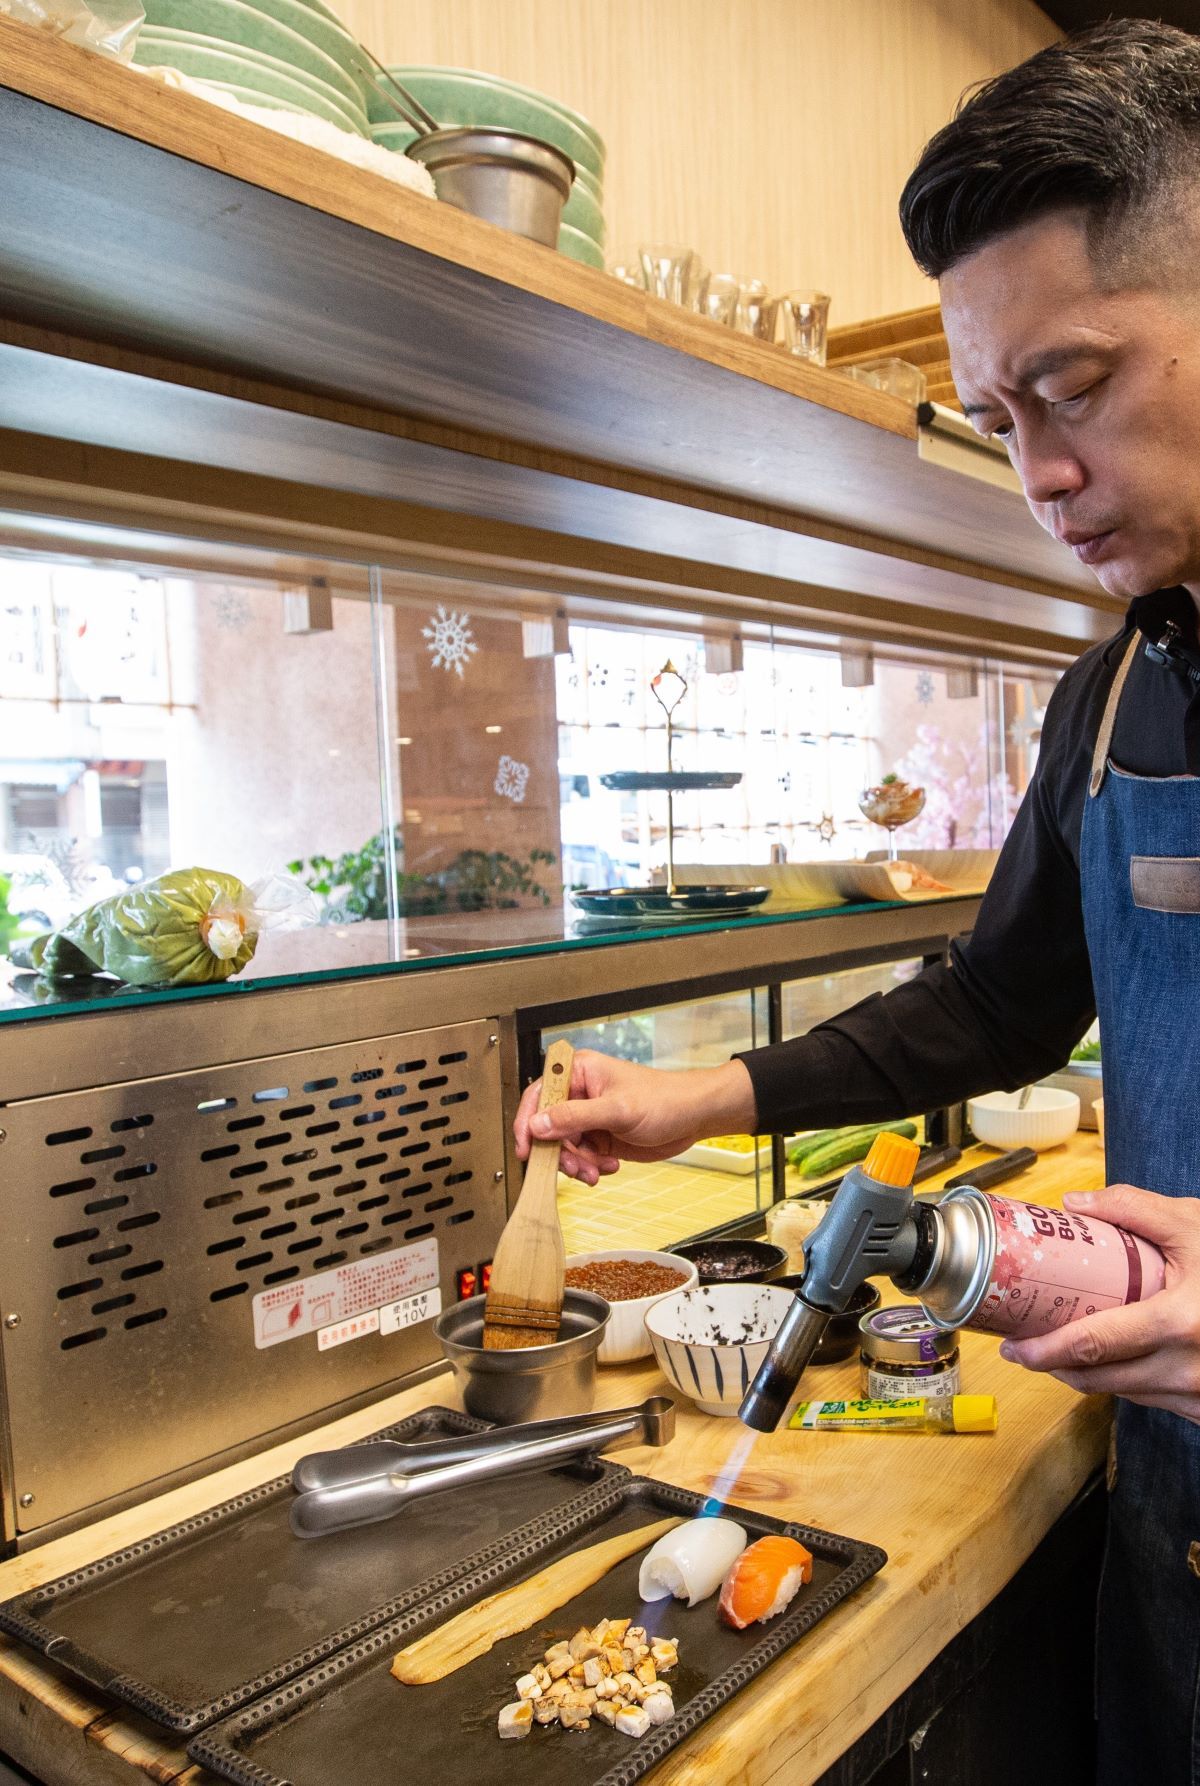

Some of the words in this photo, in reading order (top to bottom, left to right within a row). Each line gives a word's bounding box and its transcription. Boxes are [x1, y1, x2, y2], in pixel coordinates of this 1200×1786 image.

[393, 1296, 429, 1315] 使用電壓
[395, 1306, 429, 1329] 110V
